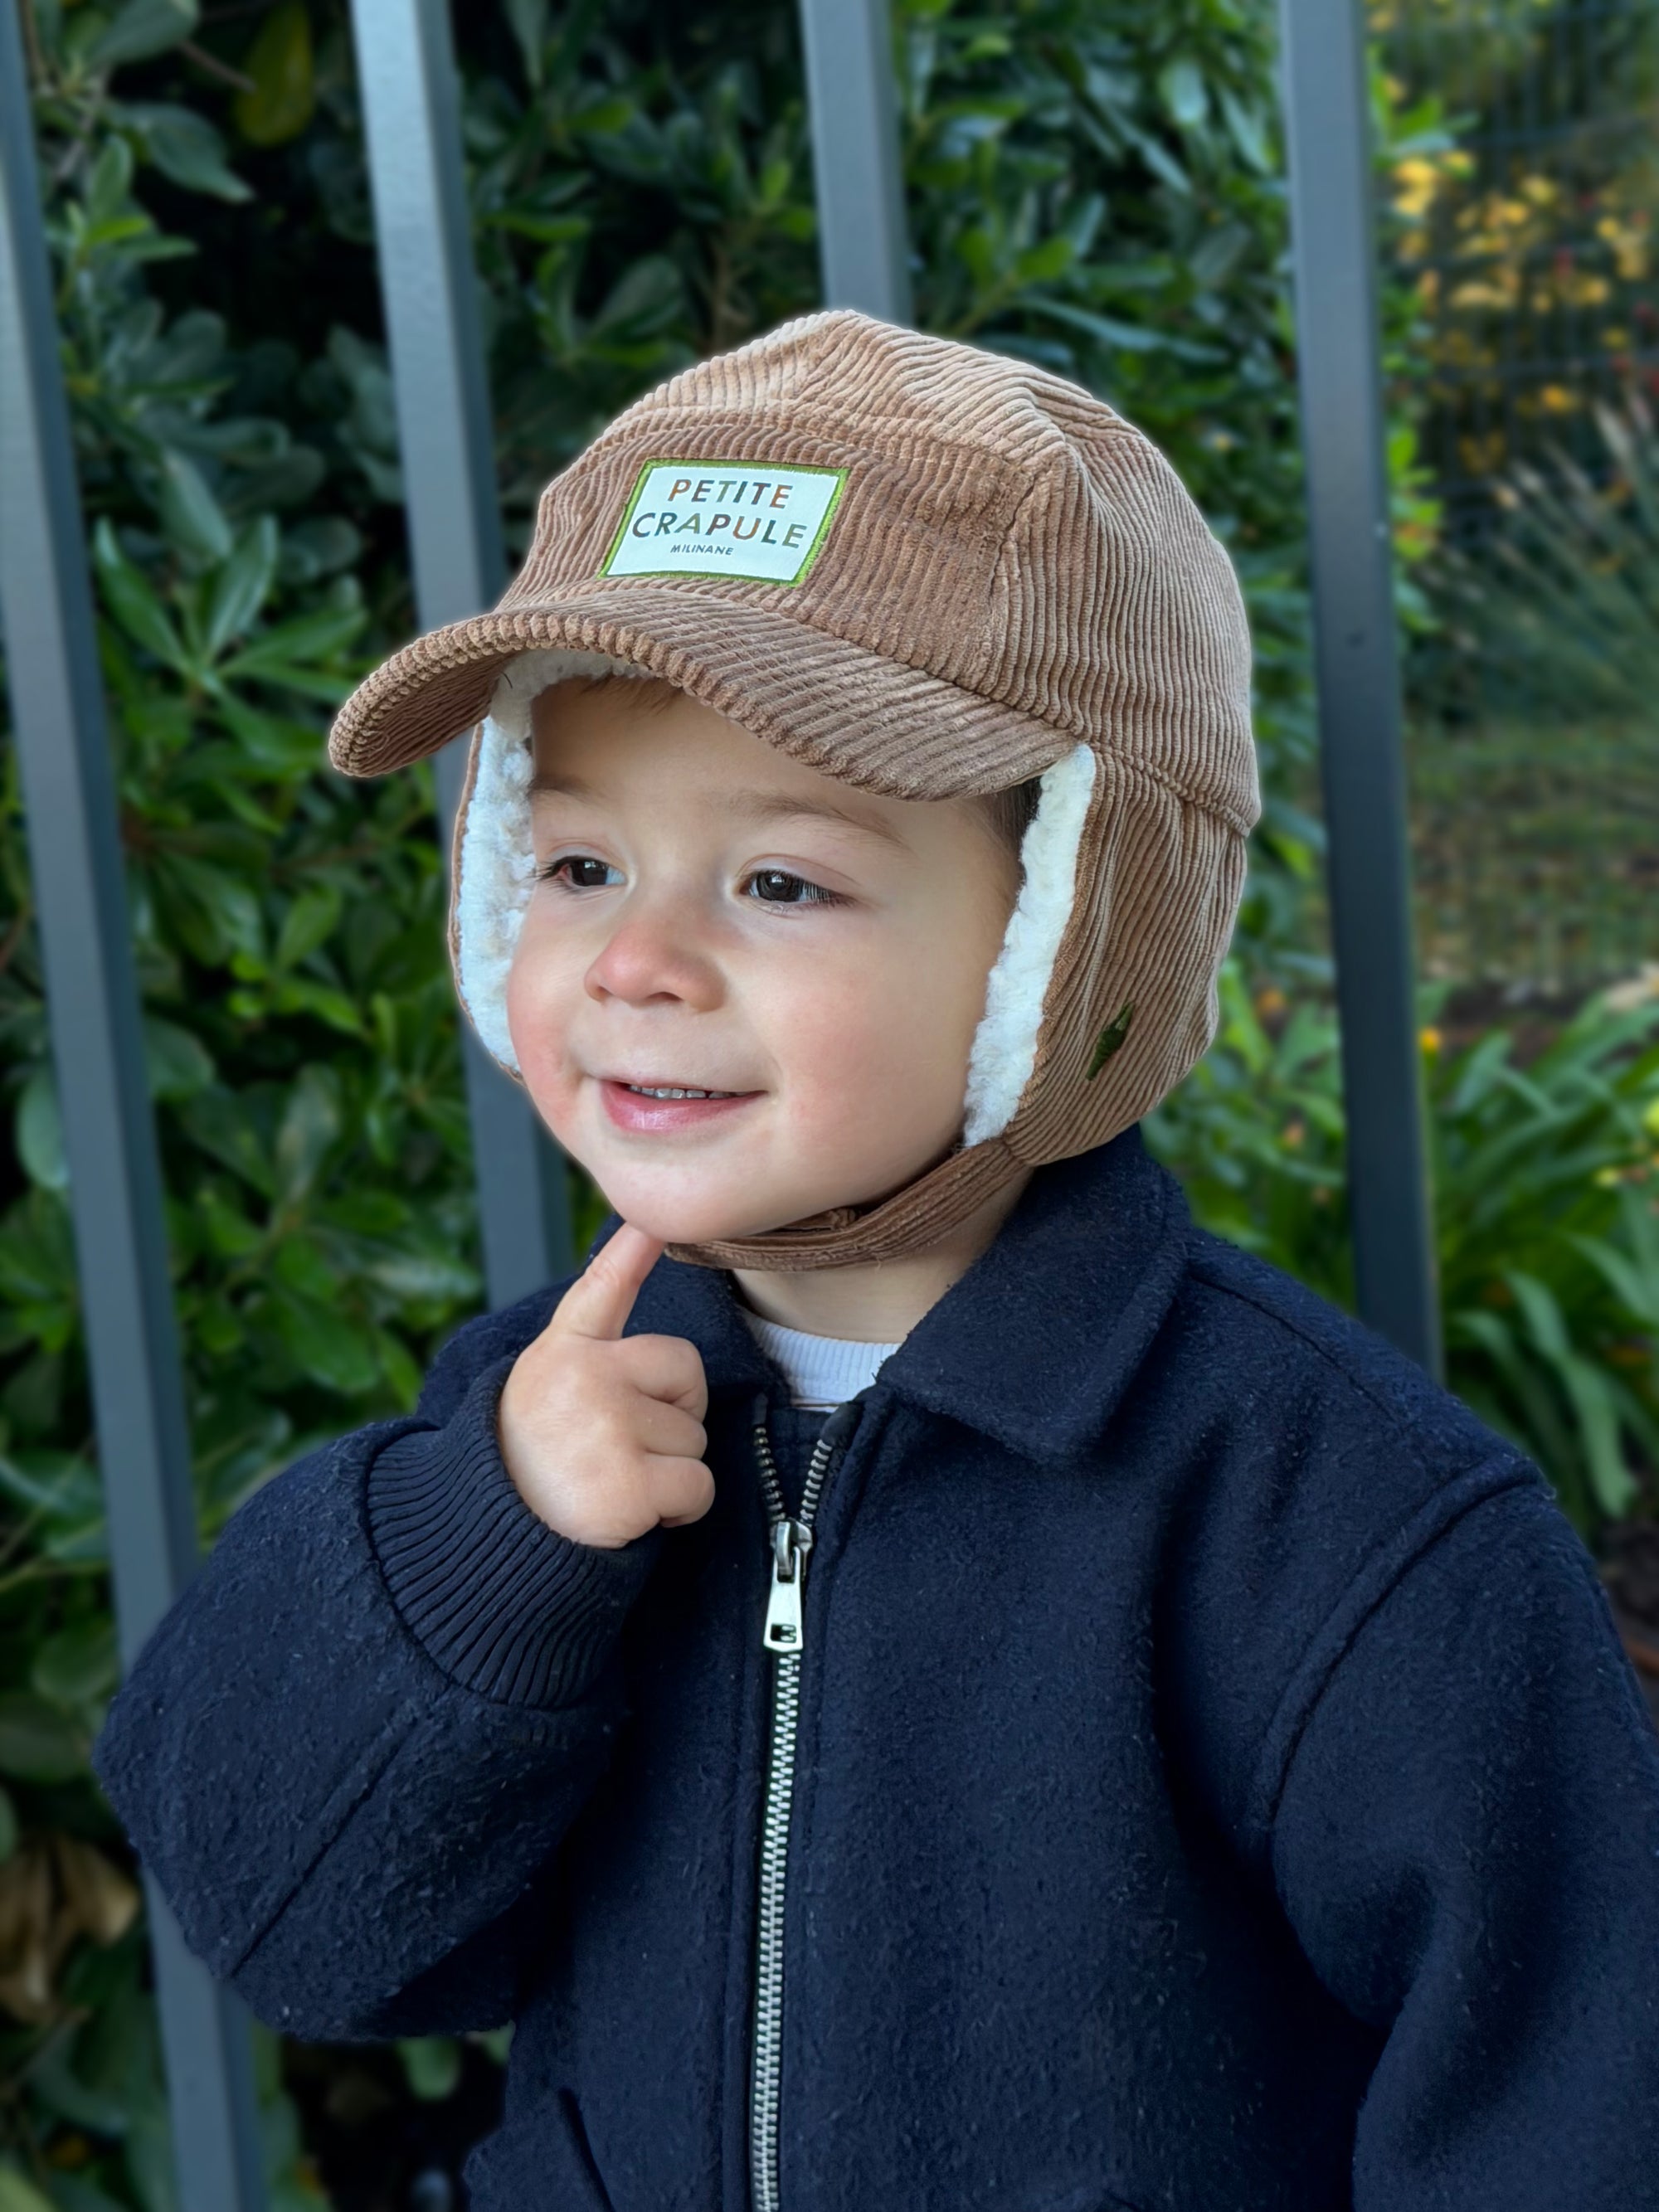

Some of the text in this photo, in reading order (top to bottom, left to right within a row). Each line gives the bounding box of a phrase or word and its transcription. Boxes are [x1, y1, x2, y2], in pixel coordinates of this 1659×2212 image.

[667, 479, 793, 508] PETITE
[632, 511, 807, 548] CRAPULE
[669, 544, 734, 555] MILINANE
